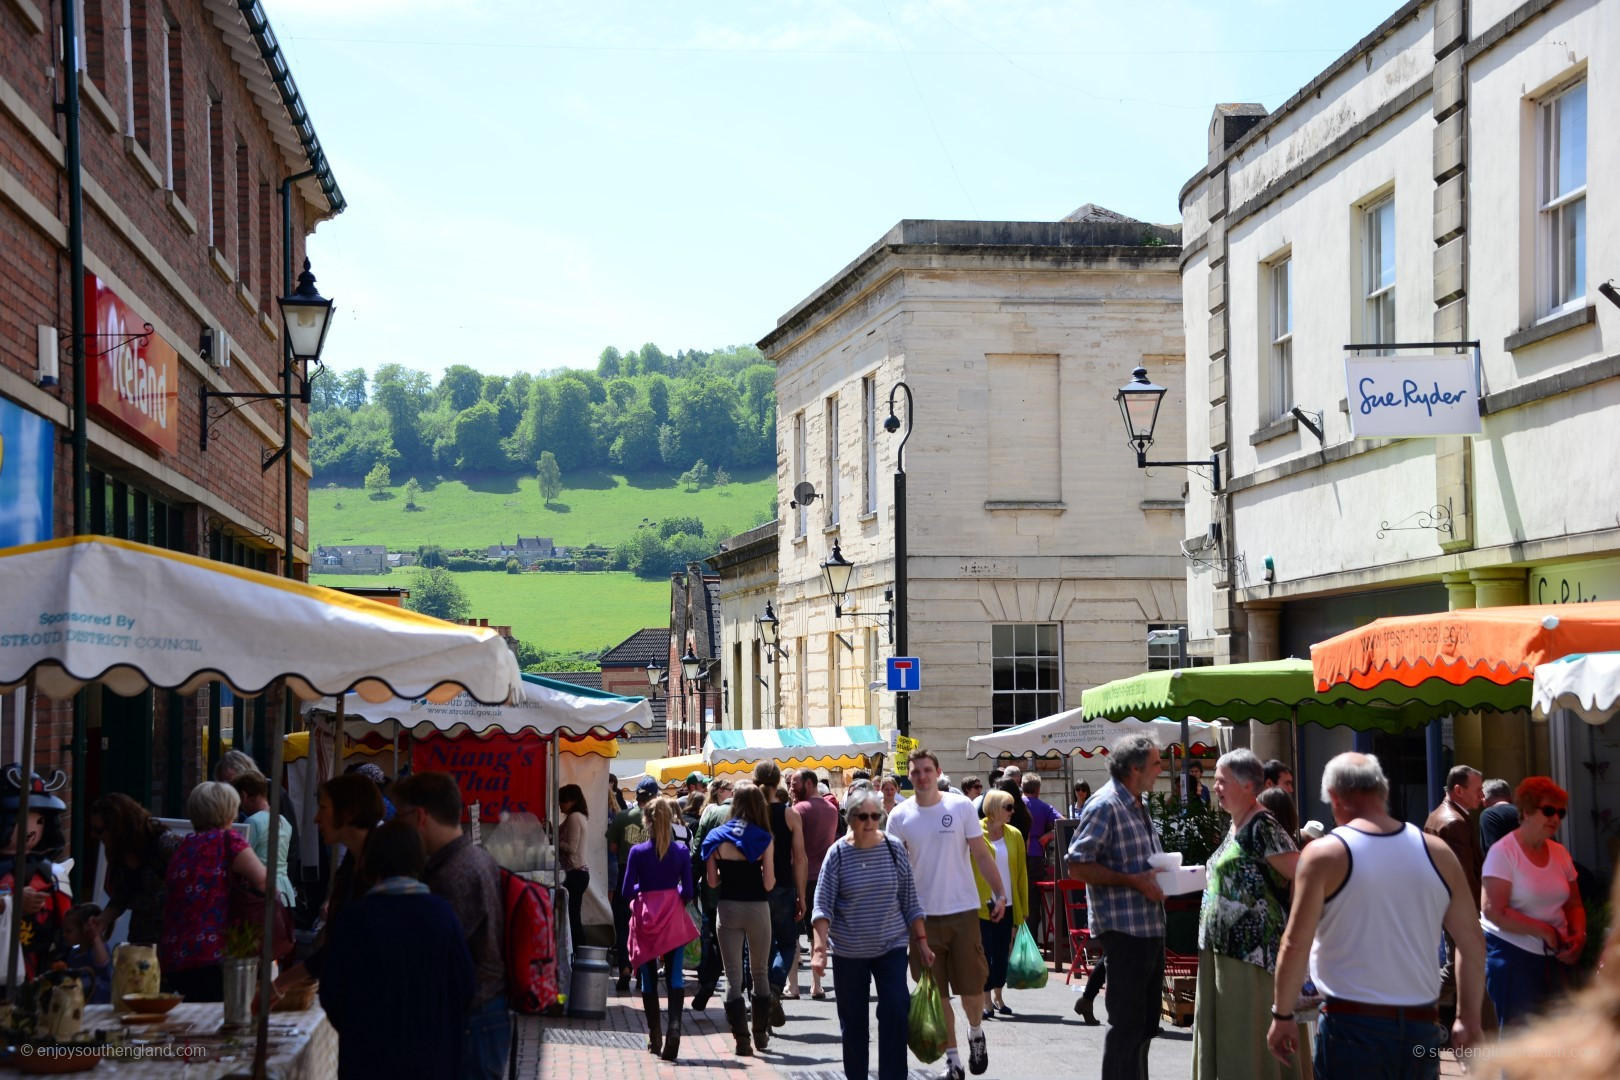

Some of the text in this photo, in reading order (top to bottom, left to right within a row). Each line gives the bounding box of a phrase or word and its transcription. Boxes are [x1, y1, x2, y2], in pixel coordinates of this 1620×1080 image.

[1359, 377, 1467, 417] Sue Ryder
[39, 611, 136, 630] Sponsored By
[1, 630, 202, 652] STROUD DISTRICT COUNCIL
[427, 707, 503, 717] www.stroud.gov.uk
[427, 743, 535, 772] Niang's
[449, 770, 512, 792] Thai
